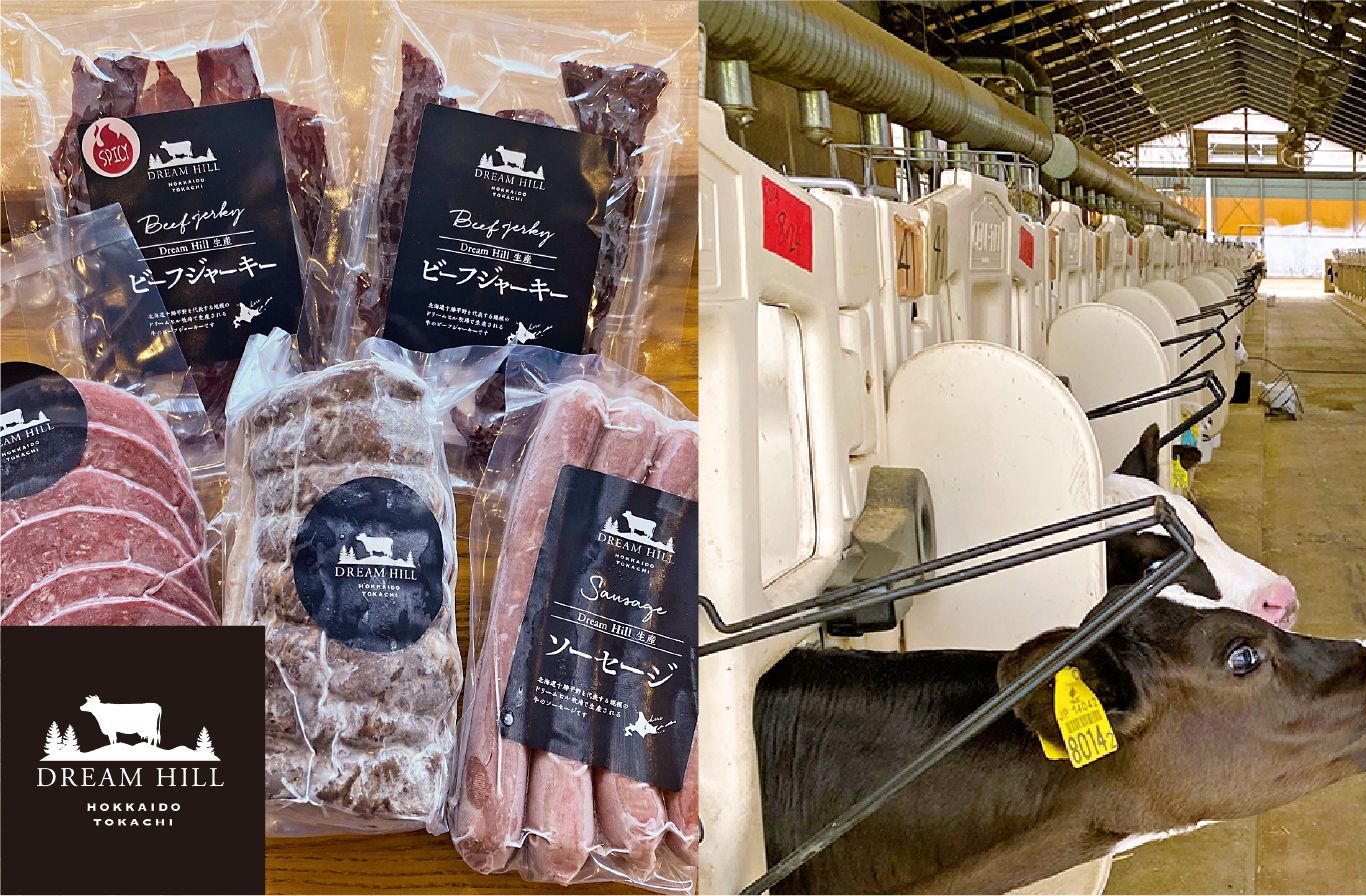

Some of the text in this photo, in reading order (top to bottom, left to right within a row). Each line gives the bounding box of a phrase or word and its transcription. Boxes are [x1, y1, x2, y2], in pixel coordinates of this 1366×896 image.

[98, 143, 129, 167] SPICY
[147, 162, 221, 181] DREAM HILL
[474, 168, 546, 191] DREAM HILL
[168, 178, 205, 187] HOKKAIDO
[172, 184, 204, 193] TOKACHI
[491, 185, 527, 197] HOKKAIDO
[492, 192, 523, 202] TOKACHI
[137, 200, 246, 235] Beef jerky
[449, 209, 556, 248] Beef jerky
[159, 236, 233, 256] Dream Hill 生産
[460, 242, 533, 265] Dream Hill 生産
[128, 255, 277, 294] ビーフジャーキー
[422, 259, 569, 302] ビーフジャーキー
[25, 422, 54, 438] HILL
[1, 440, 39, 457] HOKKAIDO
[6, 448, 39, 462] TOKACHI
[598, 532, 675, 565] DREAM HILL
[614, 553, 655, 569] HOKKAIDO
[616, 560, 650, 574] TOKACHI
[335, 566, 417, 580] DREAM HILL
[358, 583, 400, 591] HOKKAIDO
[580, 575, 668, 623] Sausage
[577, 612, 657, 646] Dream Hill 生産
[545, 634, 678, 688] ソーセージ
